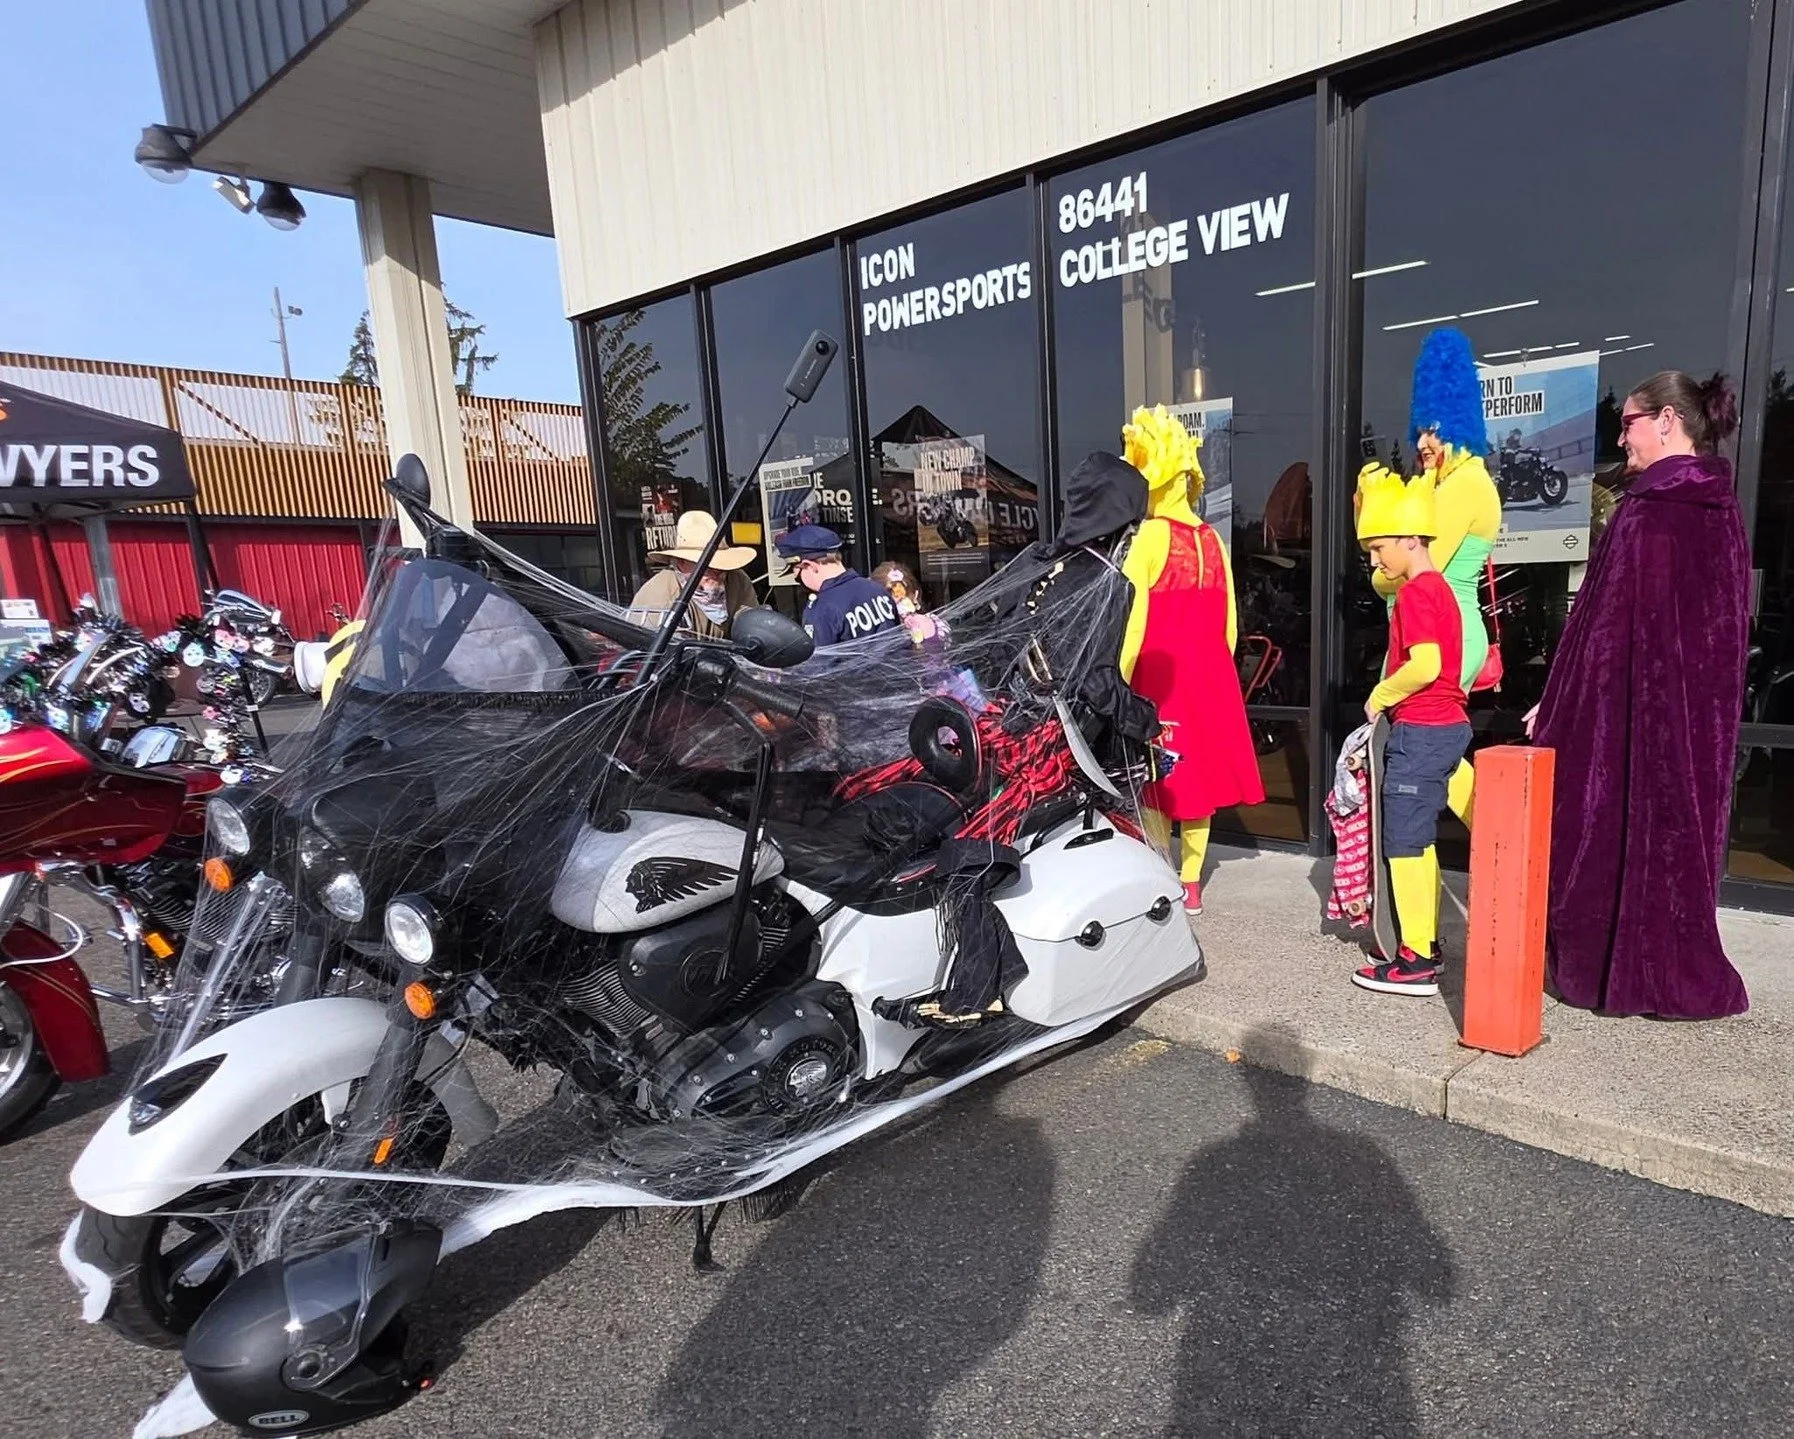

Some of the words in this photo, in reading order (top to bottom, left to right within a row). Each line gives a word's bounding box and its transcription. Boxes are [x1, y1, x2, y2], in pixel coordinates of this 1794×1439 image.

[1058, 171, 1147, 234] 86441
[1059, 219, 1189, 288] COLLEGE
[1196, 193, 1290, 256] VIEW
[860, 242, 916, 290] ICON
[862, 261, 1032, 336] POWERSPORTS
[1480, 379, 1495, 399] RN
[1498, 376, 1512, 395] TO
[1484, 392, 1543, 418] PERFORM
[921, 450, 942, 471] NEW
[943, 446, 975, 470] CHAMP
[845, 595, 895, 638] POLIC
[258, 1414, 300, 1425] BELL
